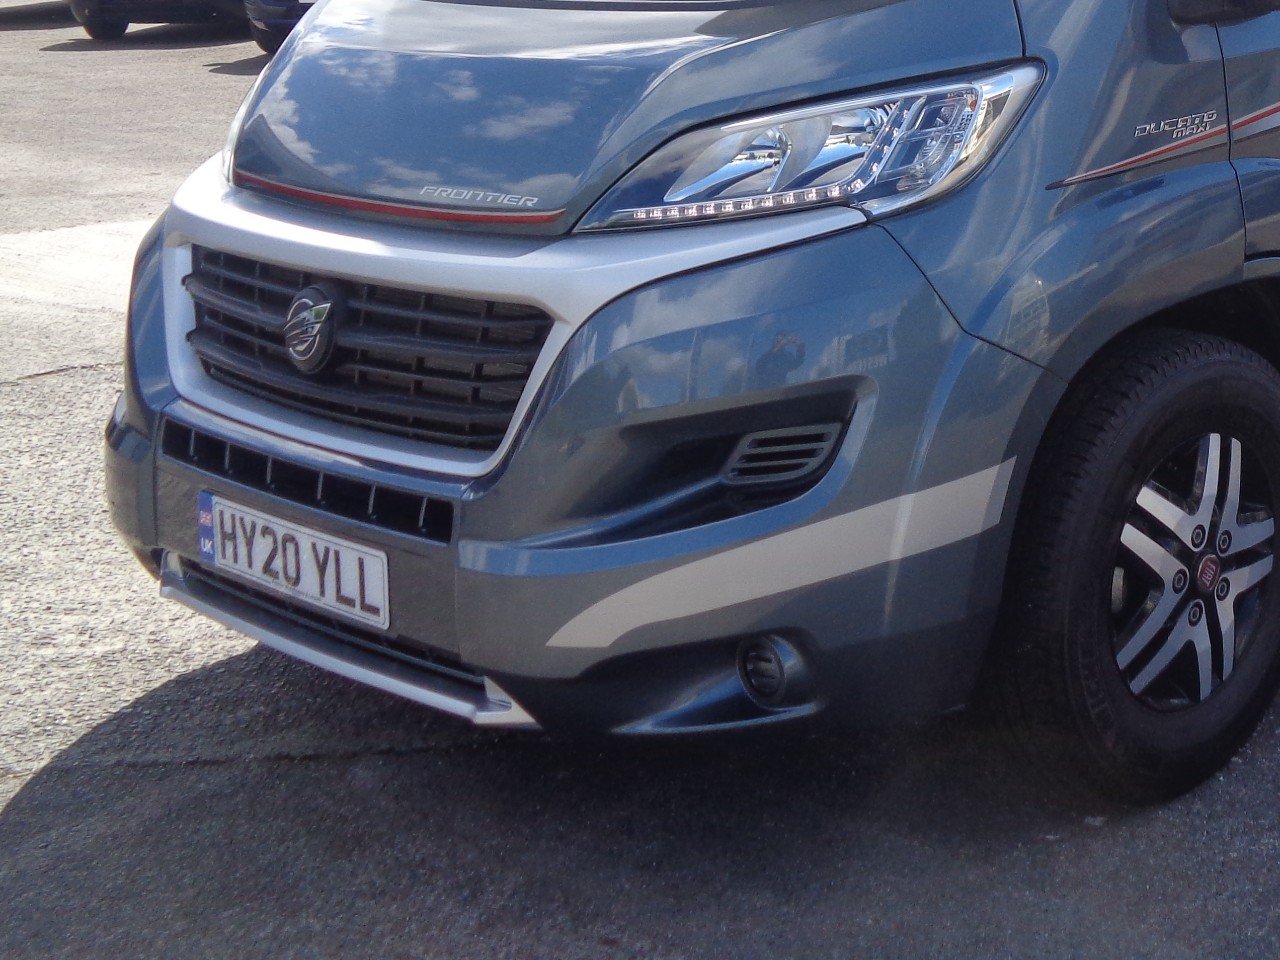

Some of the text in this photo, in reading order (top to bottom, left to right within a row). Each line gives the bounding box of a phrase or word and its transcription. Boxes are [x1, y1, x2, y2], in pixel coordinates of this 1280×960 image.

[1134, 110, 1217, 138] DUCATO
[1172, 121, 1211, 139] MAXI
[419, 186, 539, 207] FRONTIER
[218, 509, 381, 618] HY20 YLL
